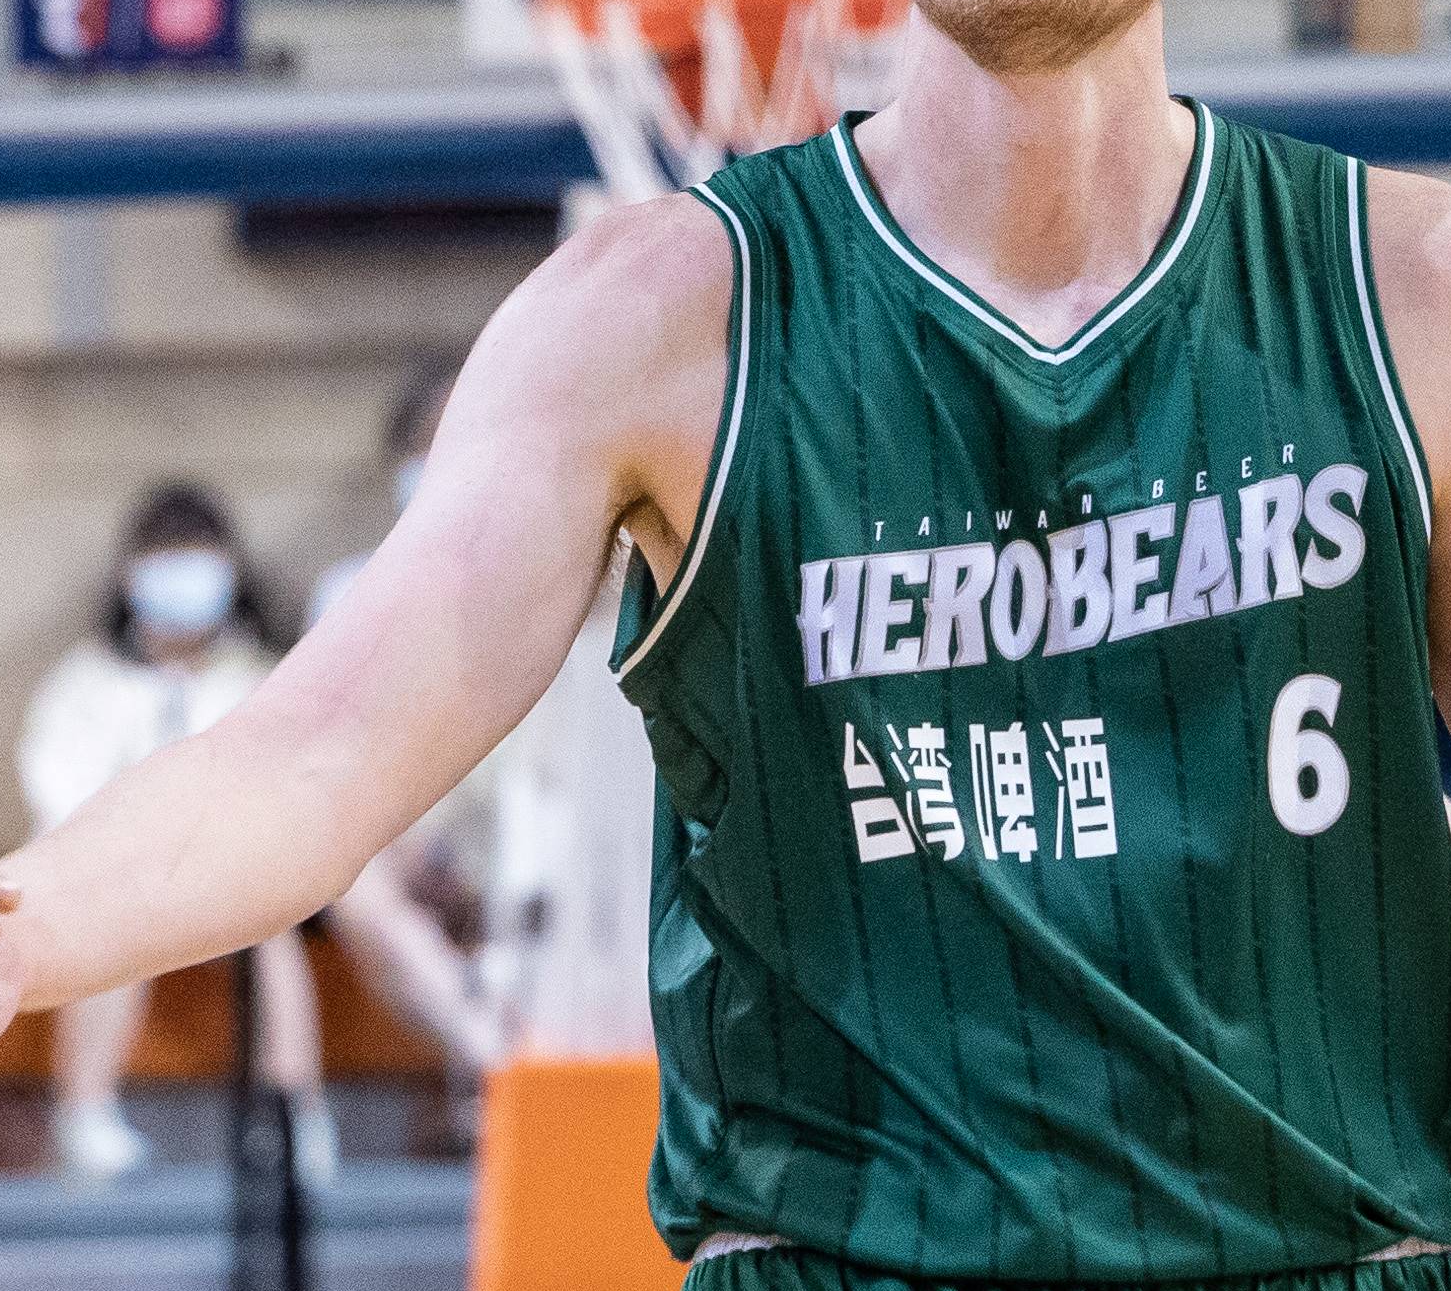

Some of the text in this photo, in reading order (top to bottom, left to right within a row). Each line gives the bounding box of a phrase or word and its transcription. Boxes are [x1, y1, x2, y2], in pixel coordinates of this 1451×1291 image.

[874, 443, 1296, 542] TAIWAN BEER
[796, 463, 1369, 687] HEROBEARS
[1266, 673, 1350, 836] 6
